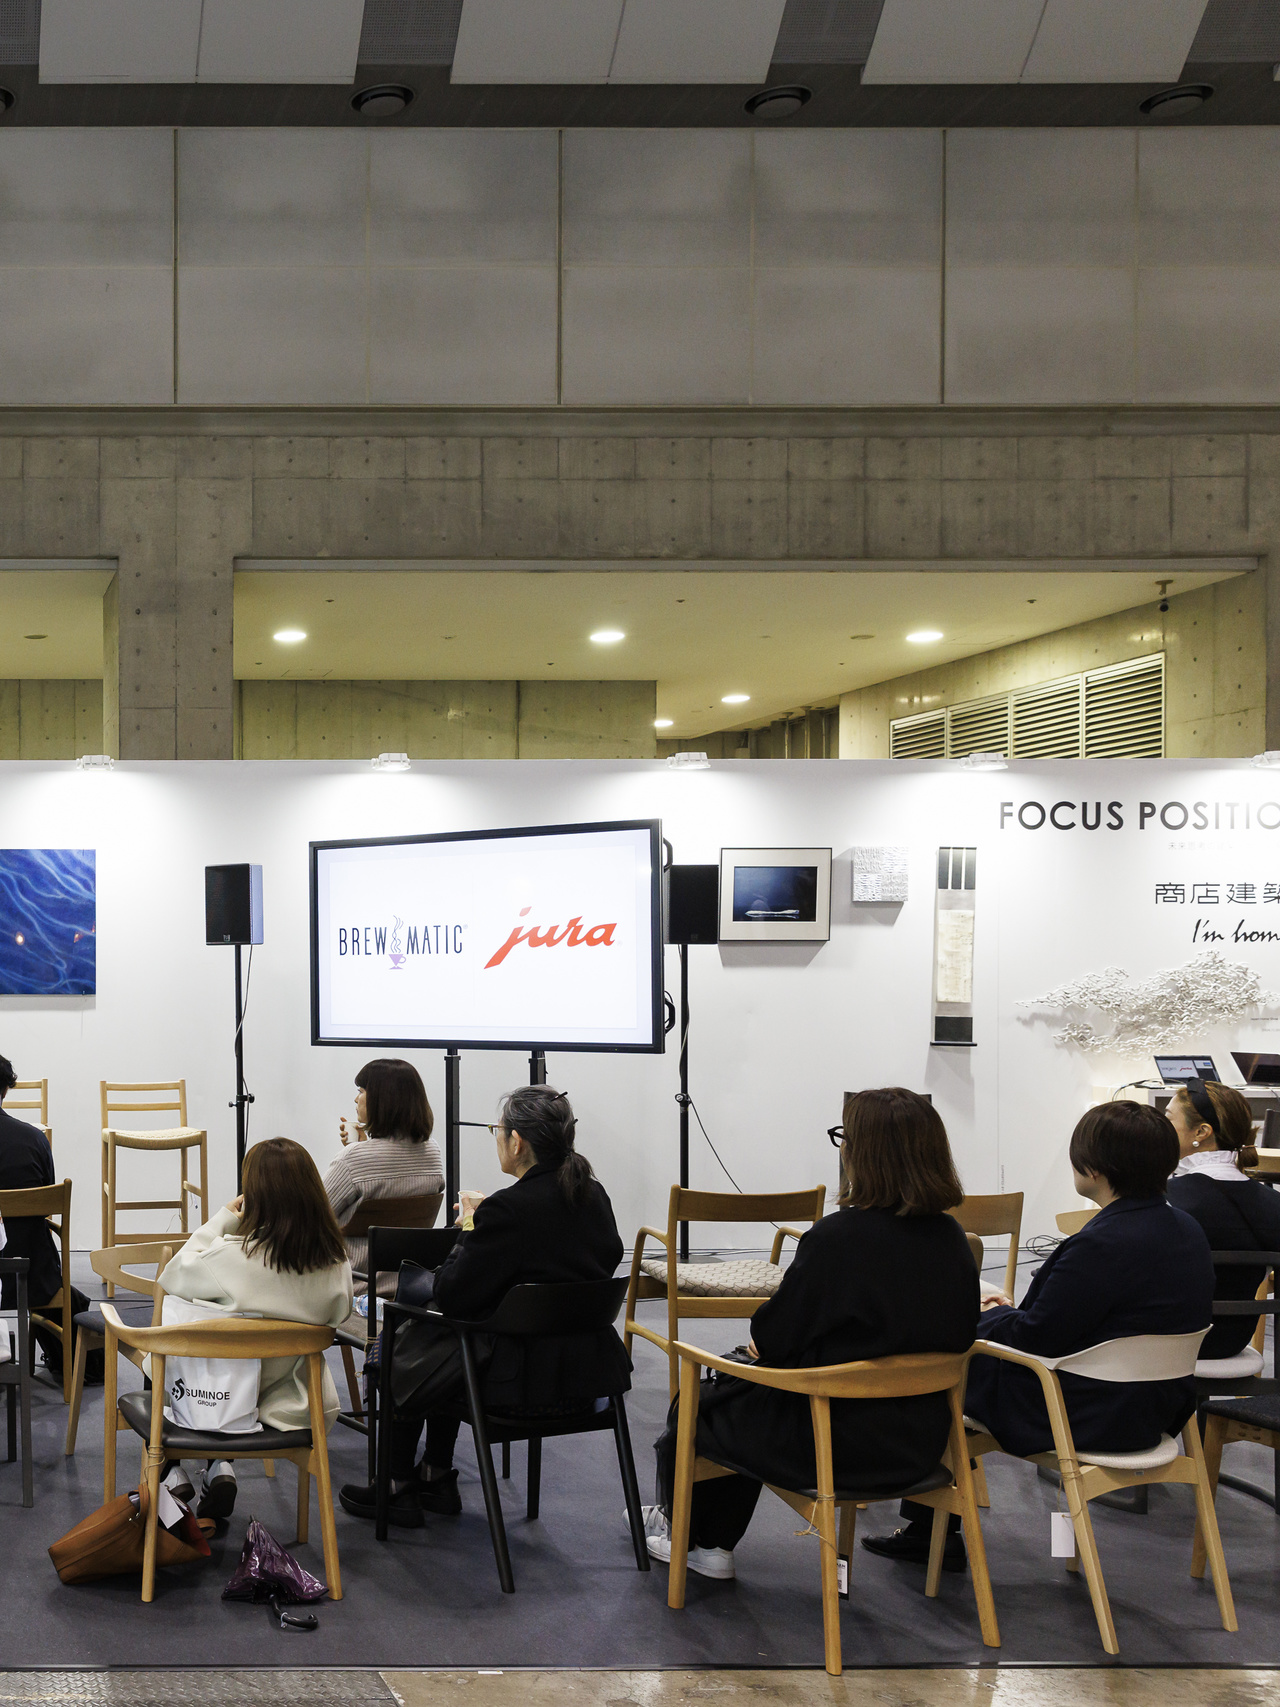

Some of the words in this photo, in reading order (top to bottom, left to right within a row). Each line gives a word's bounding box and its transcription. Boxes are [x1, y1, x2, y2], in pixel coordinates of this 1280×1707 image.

[999, 801, 1124, 831] FOCUS
[1138, 801, 1280, 831] POSITIO
[338, 926, 388, 956] BREW
[405, 925, 463, 955] MATIC
[483, 906, 617, 970] jura
[186, 1388, 231, 1400] SUMINOE
[197, 1399, 217, 1407] GROUP
